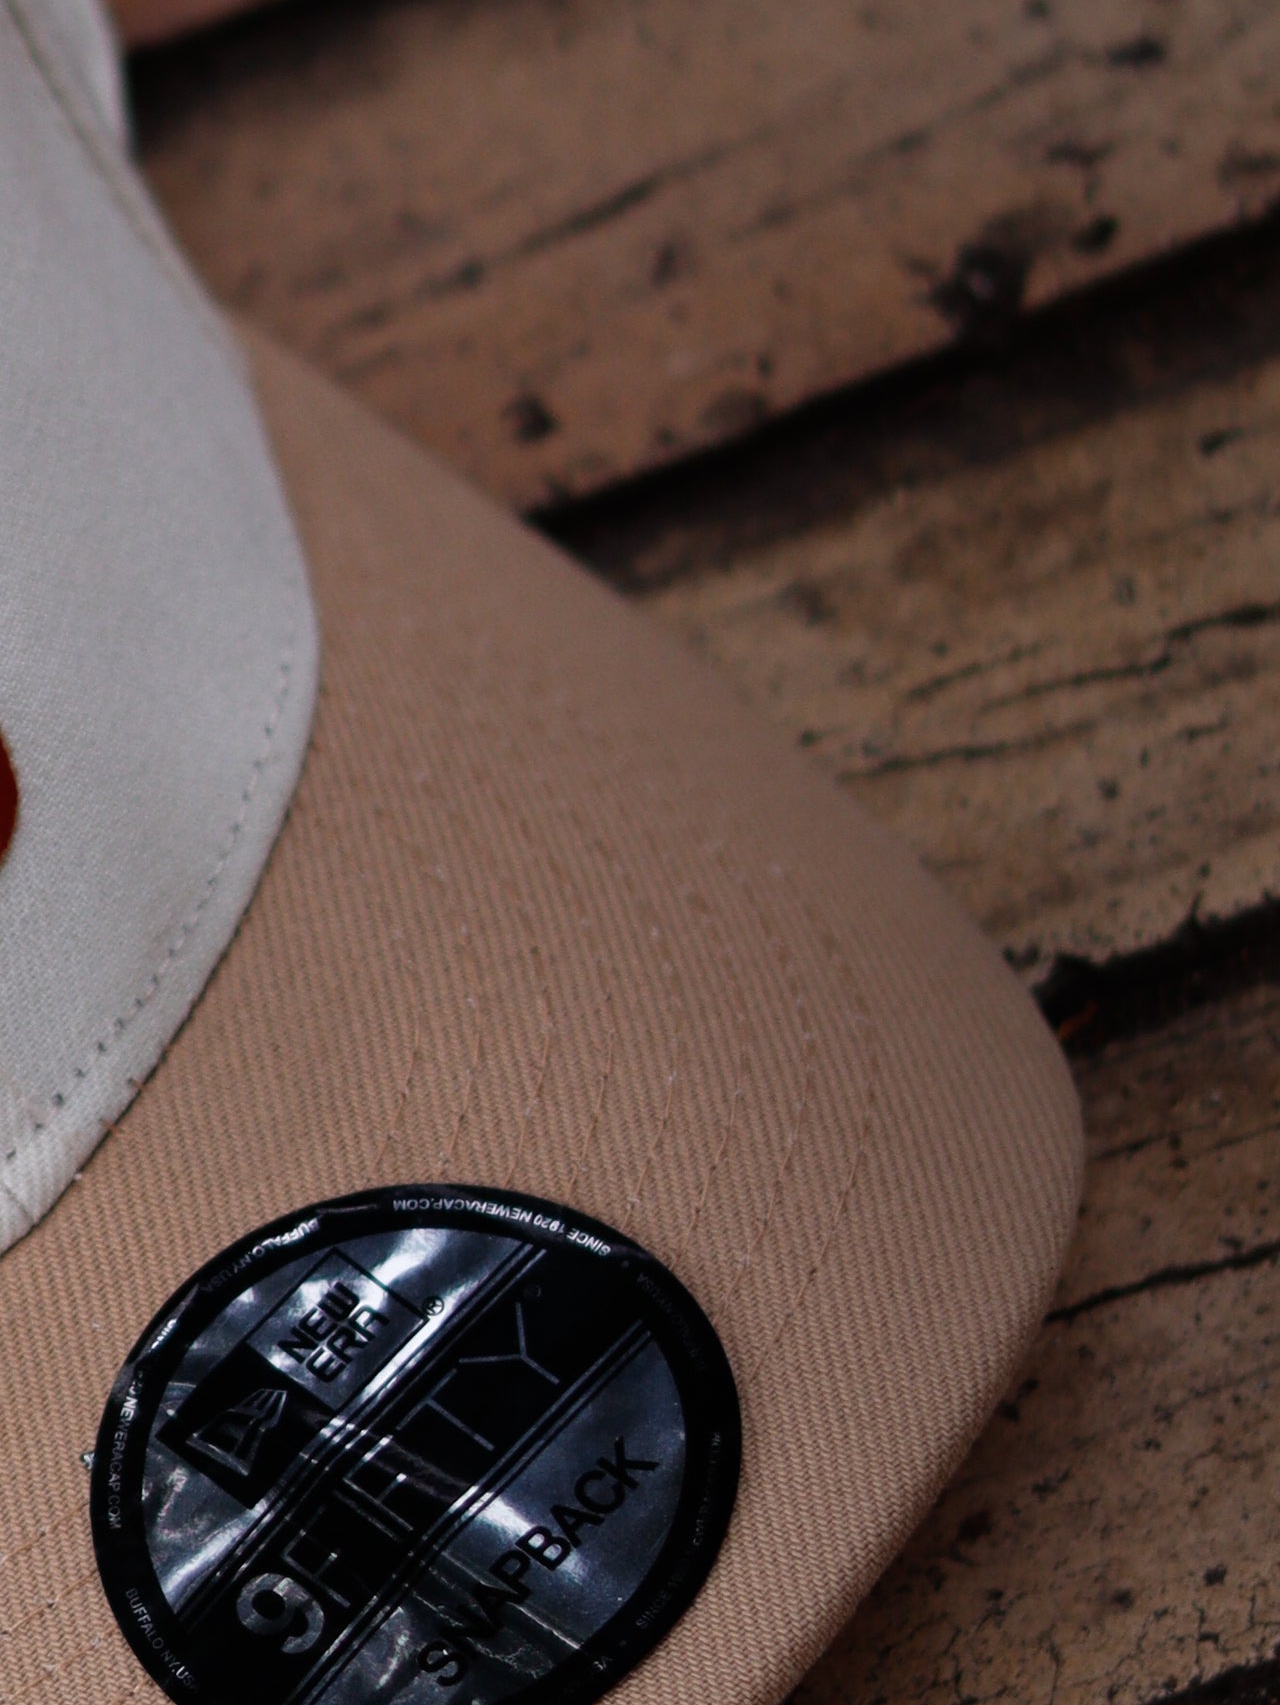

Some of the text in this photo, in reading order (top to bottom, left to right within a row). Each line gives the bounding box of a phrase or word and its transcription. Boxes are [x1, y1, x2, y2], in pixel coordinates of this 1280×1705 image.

[392, 1195, 614, 1257] SINCE 1920 NEWERACAP.COM
[276, 1281, 360, 1364] NEW
[305, 1305, 391, 1384] ERA
[236, 1300, 561, 1655] 9FIFTY
[416, 1435, 661, 1687] SNAPBACK
